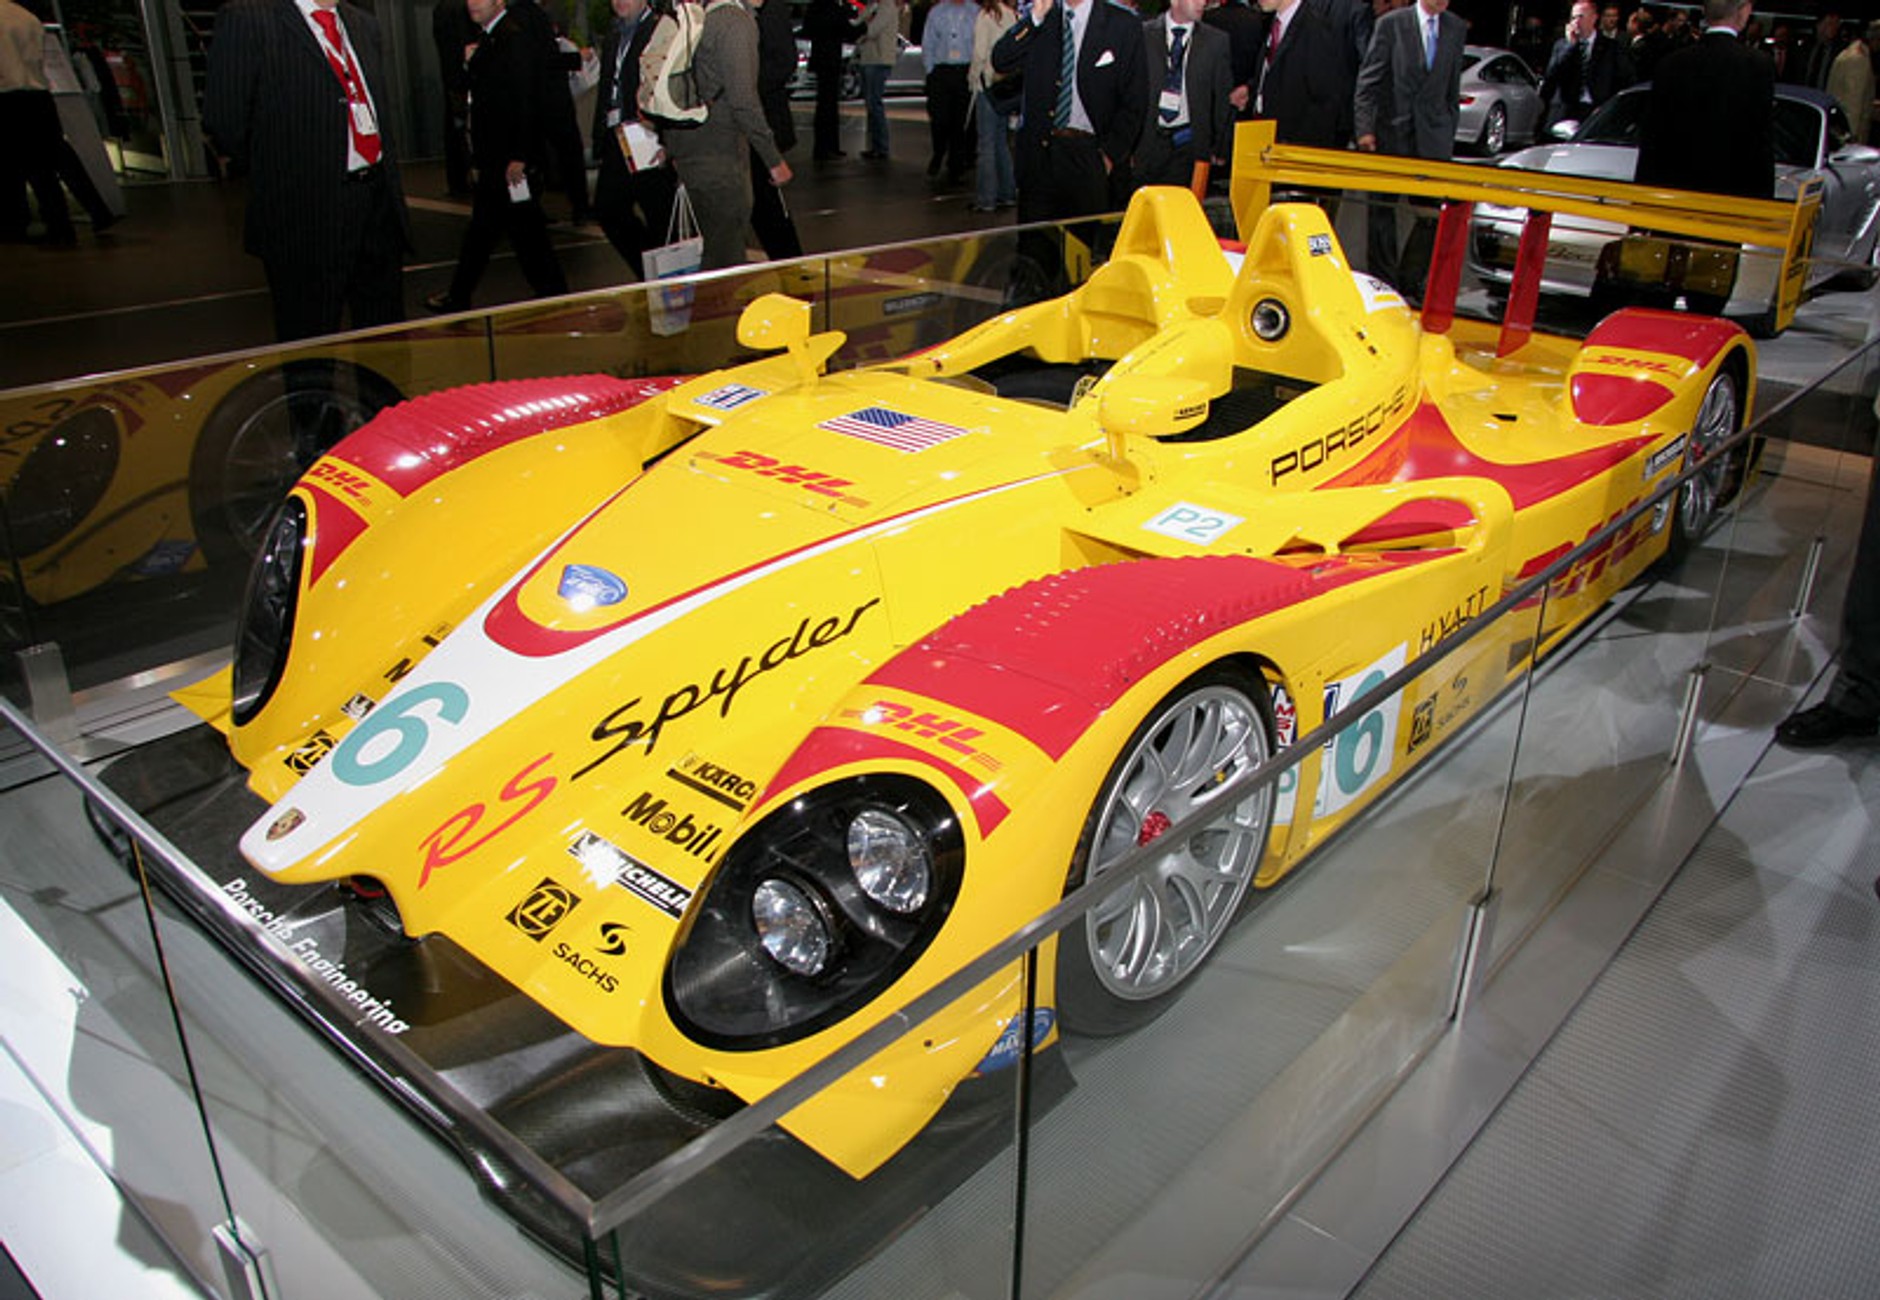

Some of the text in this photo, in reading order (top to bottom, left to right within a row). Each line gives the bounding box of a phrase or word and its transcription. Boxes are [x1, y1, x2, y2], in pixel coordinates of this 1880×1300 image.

[1271, 385, 1405, 487] PORSCHE
[307, 462, 371, 498] DHL
[715, 451, 855, 498] DHL
[1157, 507, 1225, 538] P2
[1418, 585, 1489, 656] HYATT
[571, 598, 881, 782] Spyder
[331, 681, 470, 787] 6
[866, 700, 986, 755] DHL
[1335, 670, 1385, 796] 6
[222, 878, 294, 940] Porsche
[552, 942, 620, 993] SACHS
